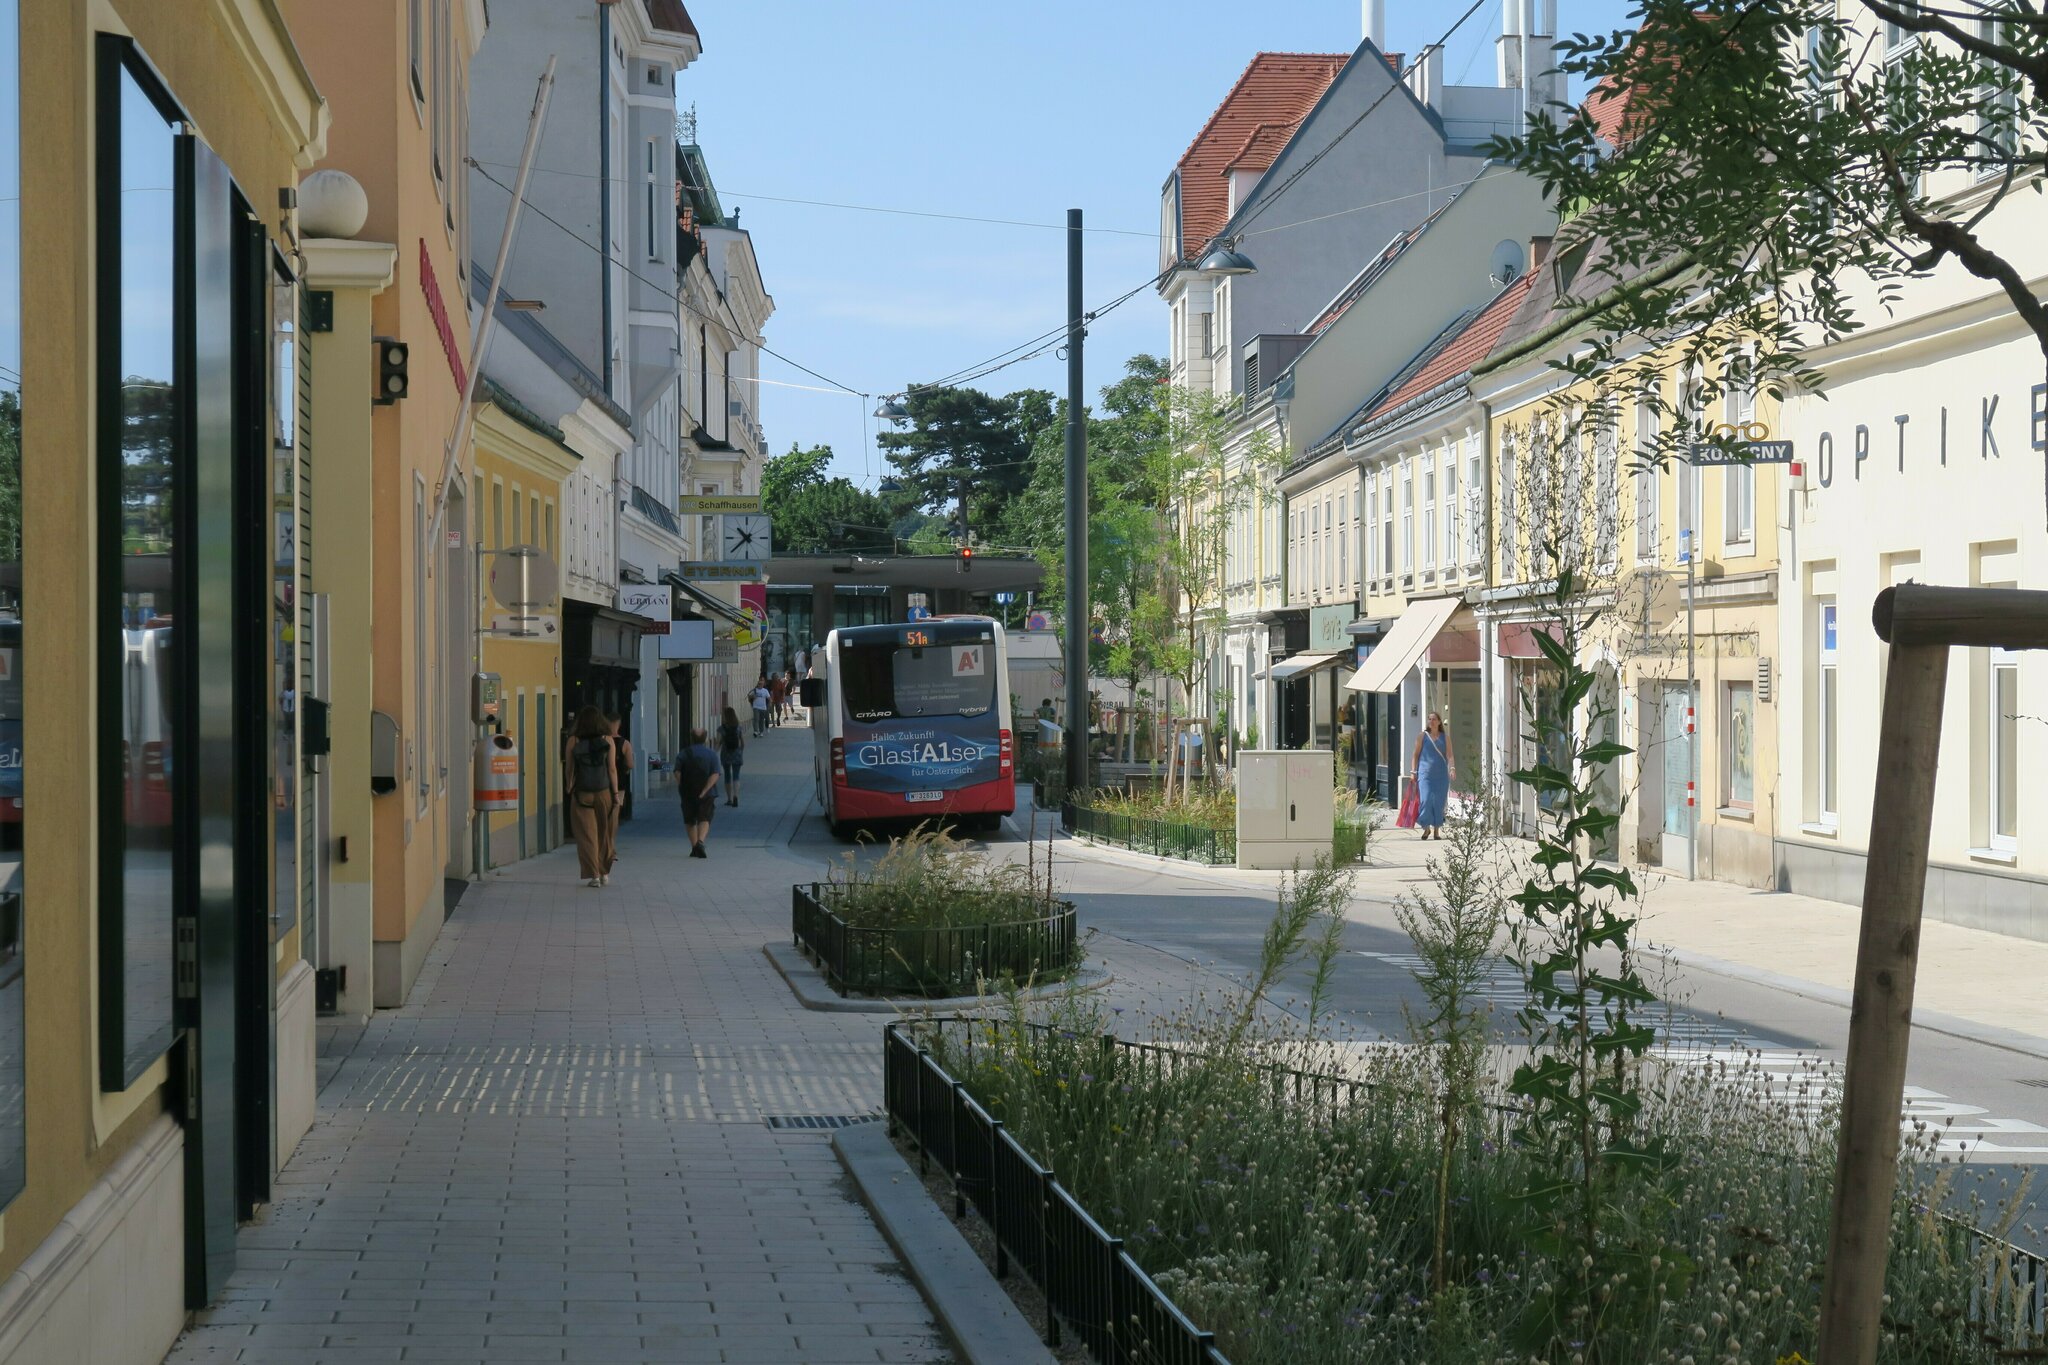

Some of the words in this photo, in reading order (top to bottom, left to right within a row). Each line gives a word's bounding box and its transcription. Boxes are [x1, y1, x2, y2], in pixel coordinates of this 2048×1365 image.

[698, 501, 758, 509] Schaffhausen
[684, 566, 757, 577] ETERNA
[623, 597, 669, 606] VERMANI
[957, 648, 979, 672] A1
[959, 706, 988, 714] hybrid
[856, 711, 892, 719] CITARO
[871, 733, 896, 743] Hallo,
[898, 731, 935, 741] Zukunft!
[859, 742, 986, 767] GlasfA1ser
[911, 768, 925, 777] für
